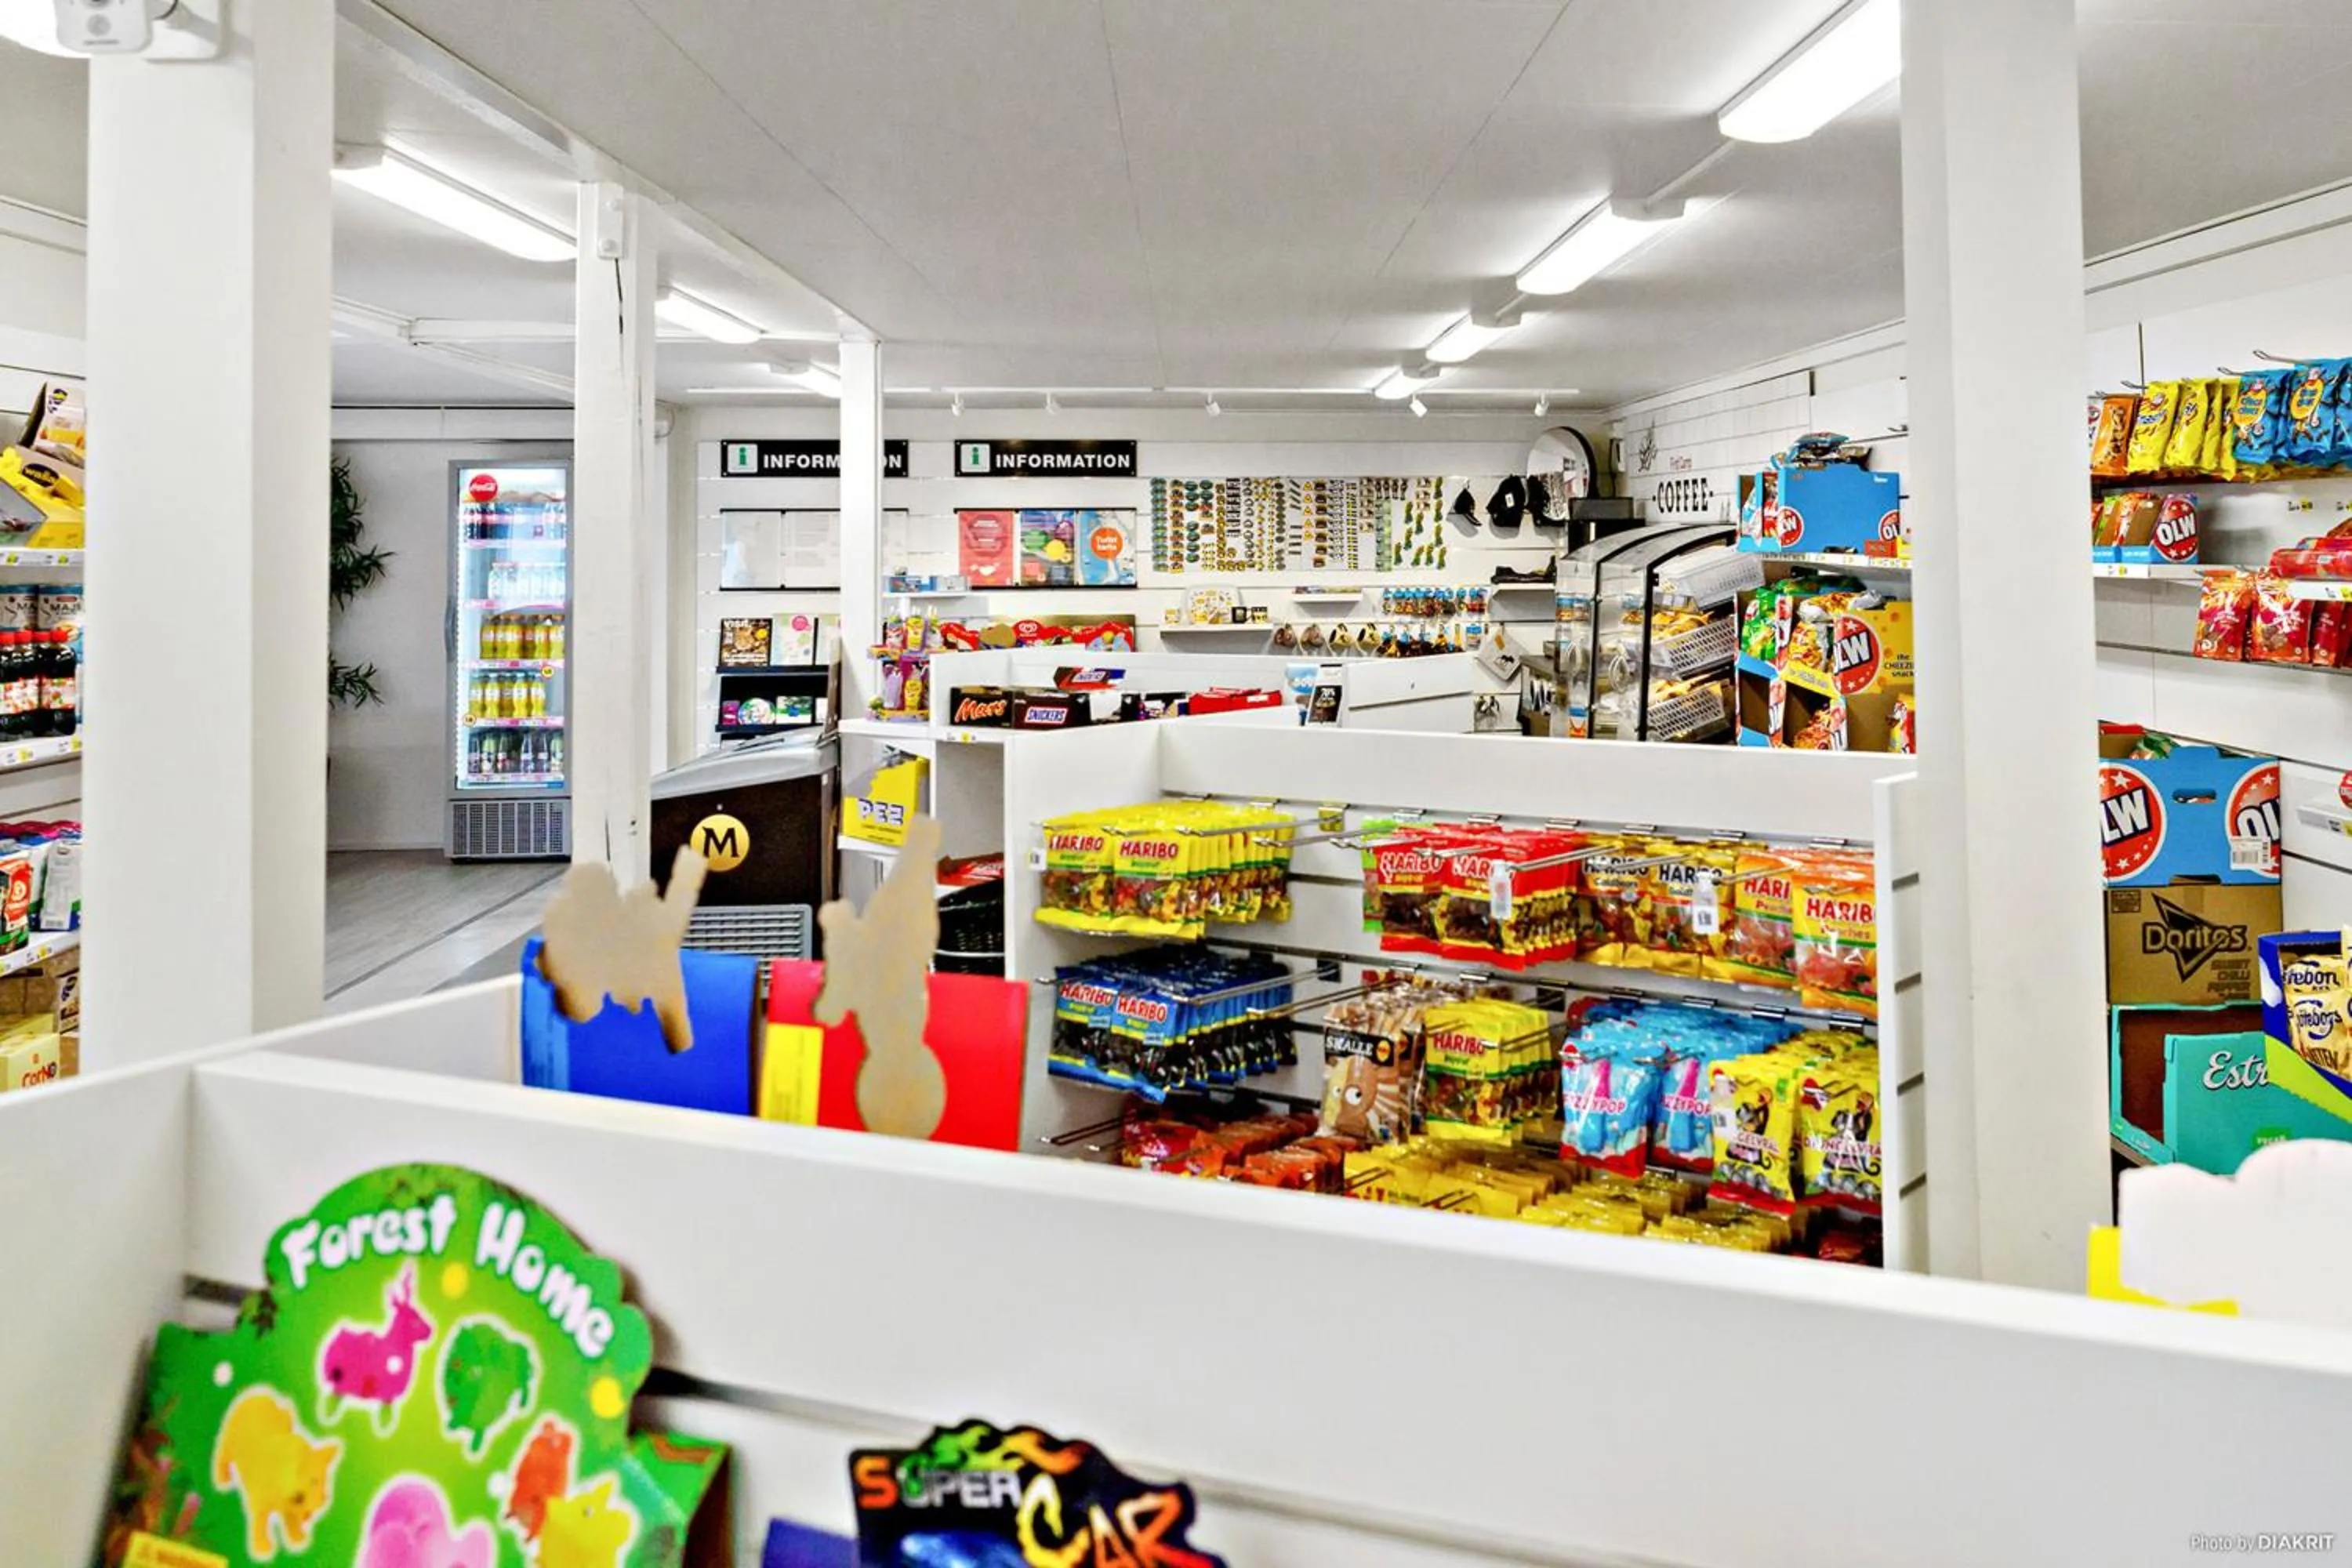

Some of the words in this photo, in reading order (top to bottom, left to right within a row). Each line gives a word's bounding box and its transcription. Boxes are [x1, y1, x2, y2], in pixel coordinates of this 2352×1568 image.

[763, 454, 902, 468] INFORMN
[995, 453, 1131, 469] INFORMATION
[1657, 477, 1708, 514] COFFEE
[2156, 513, 2196, 546] OLW
[1833, 630, 1871, 676] LW
[954, 697, 1007, 723] Mars
[1026, 708, 1066, 722] SNICKERS
[2100, 787, 2150, 844] LW
[2237, 798, 2280, 841] OL
[702, 826, 739, 858] M
[1120, 840, 1178, 859] HARIBO
[1744, 877, 1791, 899] HARI
[1806, 897, 1874, 923] HARIB
[2145, 924, 2245, 951] Doritos
[1116, 994, 1167, 1022] HARIBO
[2202, 1050, 2270, 1090] Estr
[281, 1194, 456, 1290] Forest
[475, 1202, 615, 1359] Home
[853, 1454, 1022, 1509] SUPER
[1018, 1472, 1218, 1568] CAR
